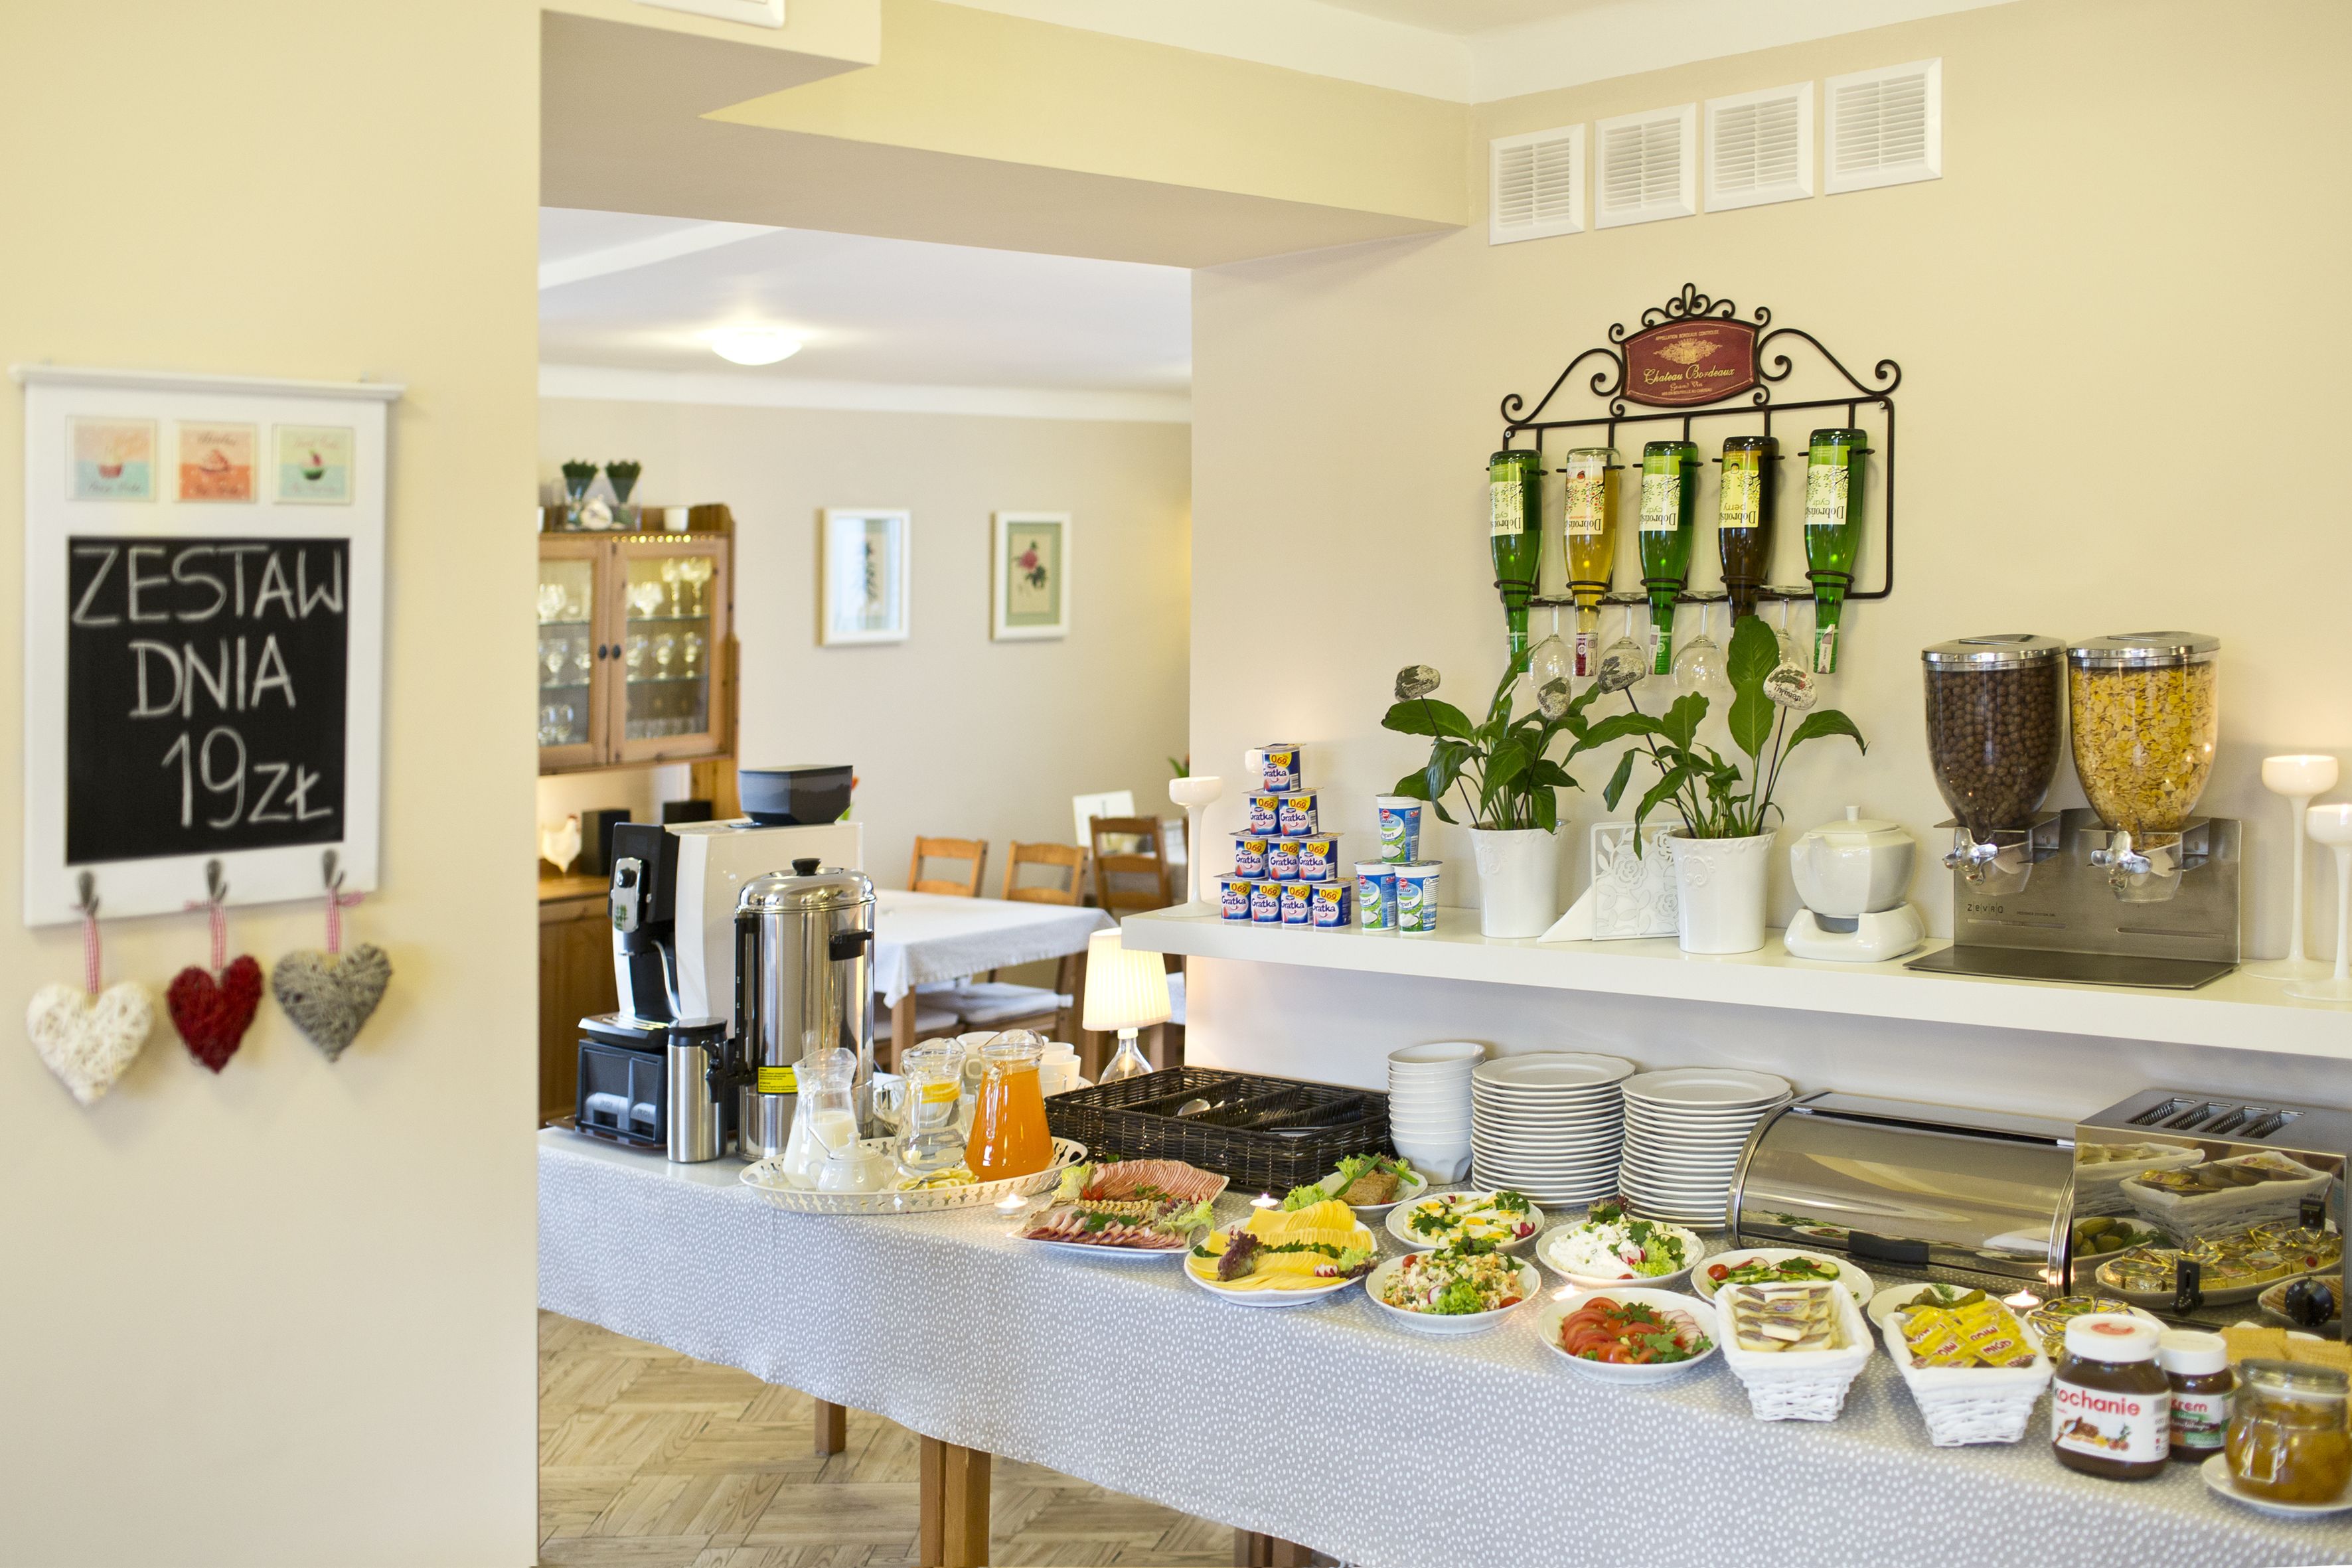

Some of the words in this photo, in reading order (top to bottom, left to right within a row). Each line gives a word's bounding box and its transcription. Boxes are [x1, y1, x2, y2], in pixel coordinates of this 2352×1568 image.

[1643, 368, 1684, 385] Chateau
[1686, 364, 1735, 380] Bordeaux
[1812, 498, 1831, 507] cydr
[71, 544, 345, 627] ZESTAW
[128, 633, 297, 720] DNIA
[1281, 813, 1306, 822] Gratka
[1235, 854, 1261, 864] Gratka
[1270, 856, 1297, 866] Gratka
[1299, 856, 1324, 866] Gratka
[1221, 896, 1246, 905] Gratka
[1252, 898, 1277, 908] Gratka
